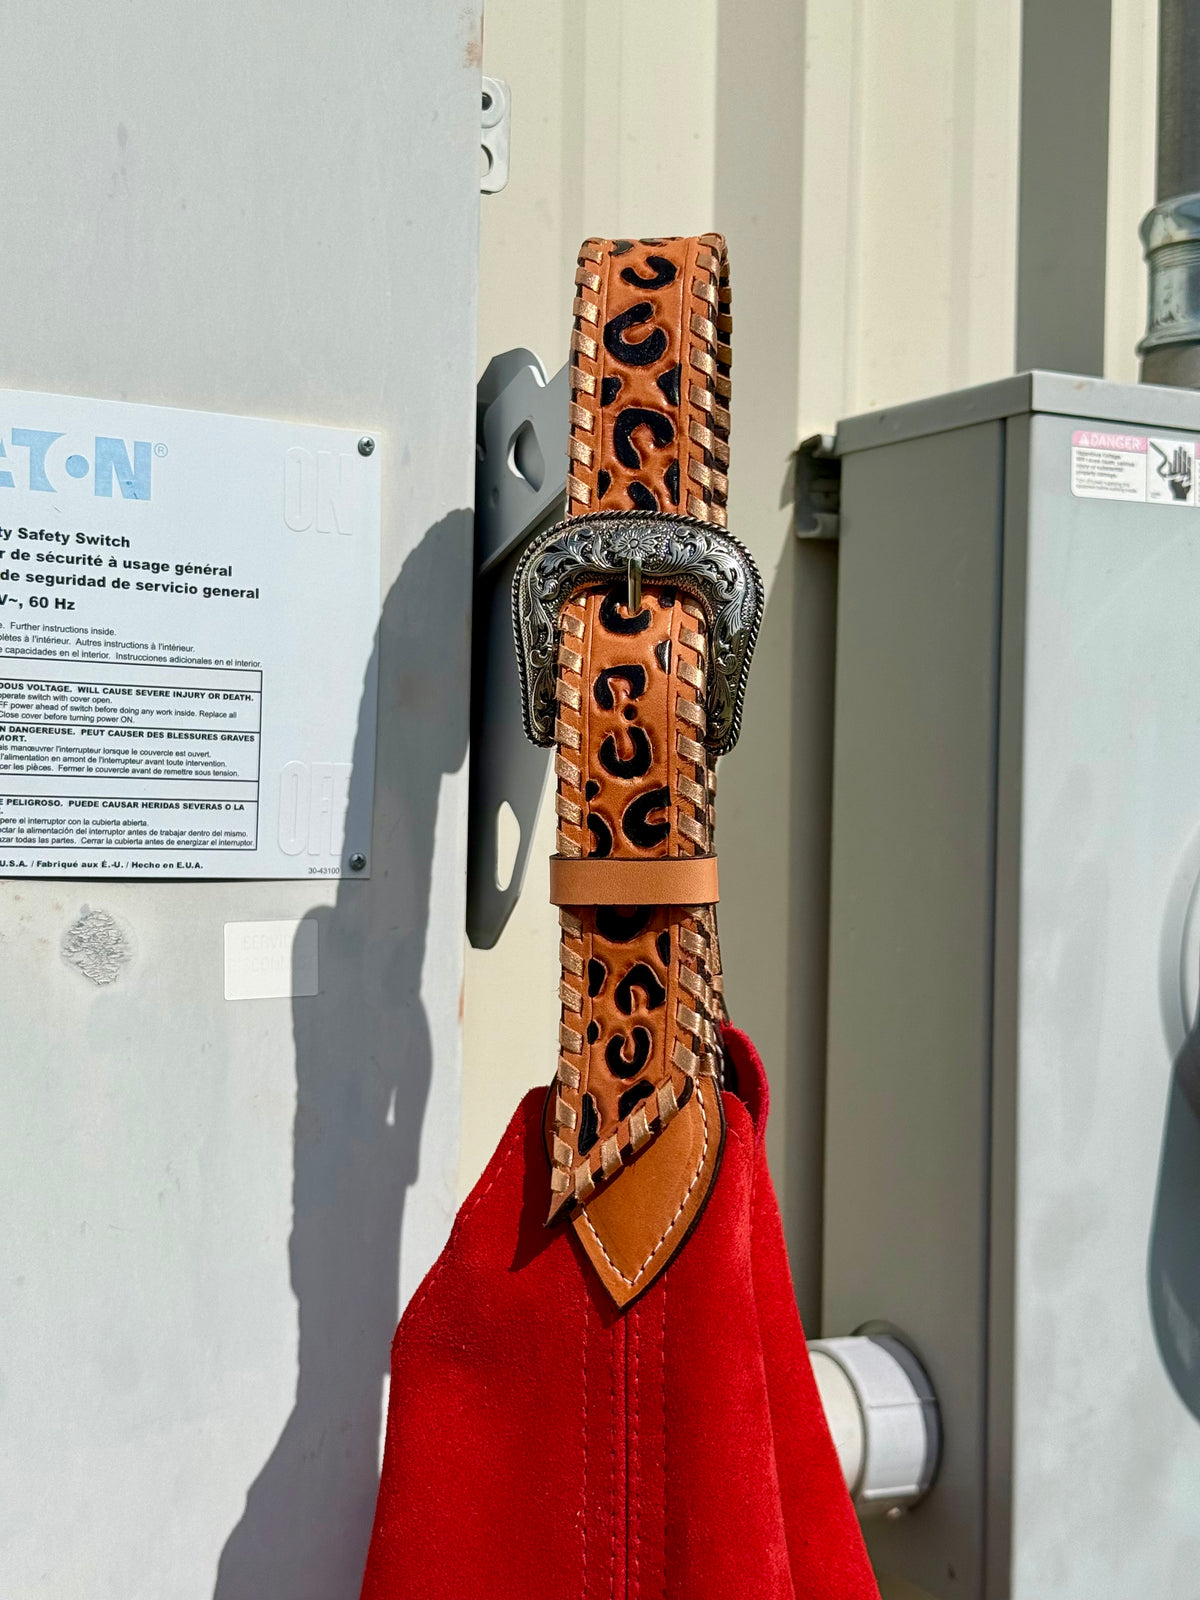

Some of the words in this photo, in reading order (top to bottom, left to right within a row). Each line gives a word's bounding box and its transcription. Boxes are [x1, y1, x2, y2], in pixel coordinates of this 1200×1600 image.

[1090, 433, 1140, 450] DANGER
[18, 528, 70, 545] Safety
[76, 533, 130, 548] Switch
[11, 549, 30, 561] de
[36, 551, 103, 566] sécurité
[108, 556, 117, 567] à
[123, 560, 170, 574] usage
[175, 562, 232, 576] général
[0, 569, 20, 581] de
[26, 574, 106, 588] seguridad
[112, 578, 130, 589] de
[136, 580, 198, 594] servicio
[203, 586, 259, 599] general
[29, 596, 49, 608] 60
[55, 598, 75, 610] Hz
[10, 622, 40, 631] Further
[43, 624, 88, 634] instructions
[91, 627, 116, 636] inside.
[32, 635, 71, 644] l'intérieur.
[75, 638, 102, 647] Autres
[104, 640, 149, 649] instructions
[151, 642, 156, 650] à
[159, 643, 195, 652] l'intérieur.
[5, 647, 57, 656] capacidades
[82, 650, 110, 659] interior.
[116, 653, 167, 662] Instrucciones
[169, 656, 212, 665] adicionales
[235, 659, 262, 667] interior.
[27, 684, 72, 692] VOLTAGE.
[78, 686, 99, 694] WILL
[136, 689, 170, 697] SEVERE
[173, 691, 205, 699] INJURY
[69, 714, 94, 723] turning
[119, 707, 139, 716] doing
[199, 710, 227, 718] Replace
[9, 726, 75, 735] DANGEREUSE.
[167, 732, 218, 740] BLESSURES
[56, 746, 101, 755] l'interrupteur
[103, 748, 129, 756] lorsque
[1, 753, 49, 761] l'alimentation
[99, 757, 143, 765] l'interrupteur
[186, 759, 226, 767] intervention.
[26, 763, 53, 772] pièces.
[58, 764, 85, 772] Fermer
[28, 817, 66, 826] interruptor
[89, 828, 125, 836] interruptor
[160, 829, 187, 837] trabajar
[51, 837, 76, 845] partes.
[177, 839, 209, 847] energizar
[37, 861, 78, 869] Fabriqué
